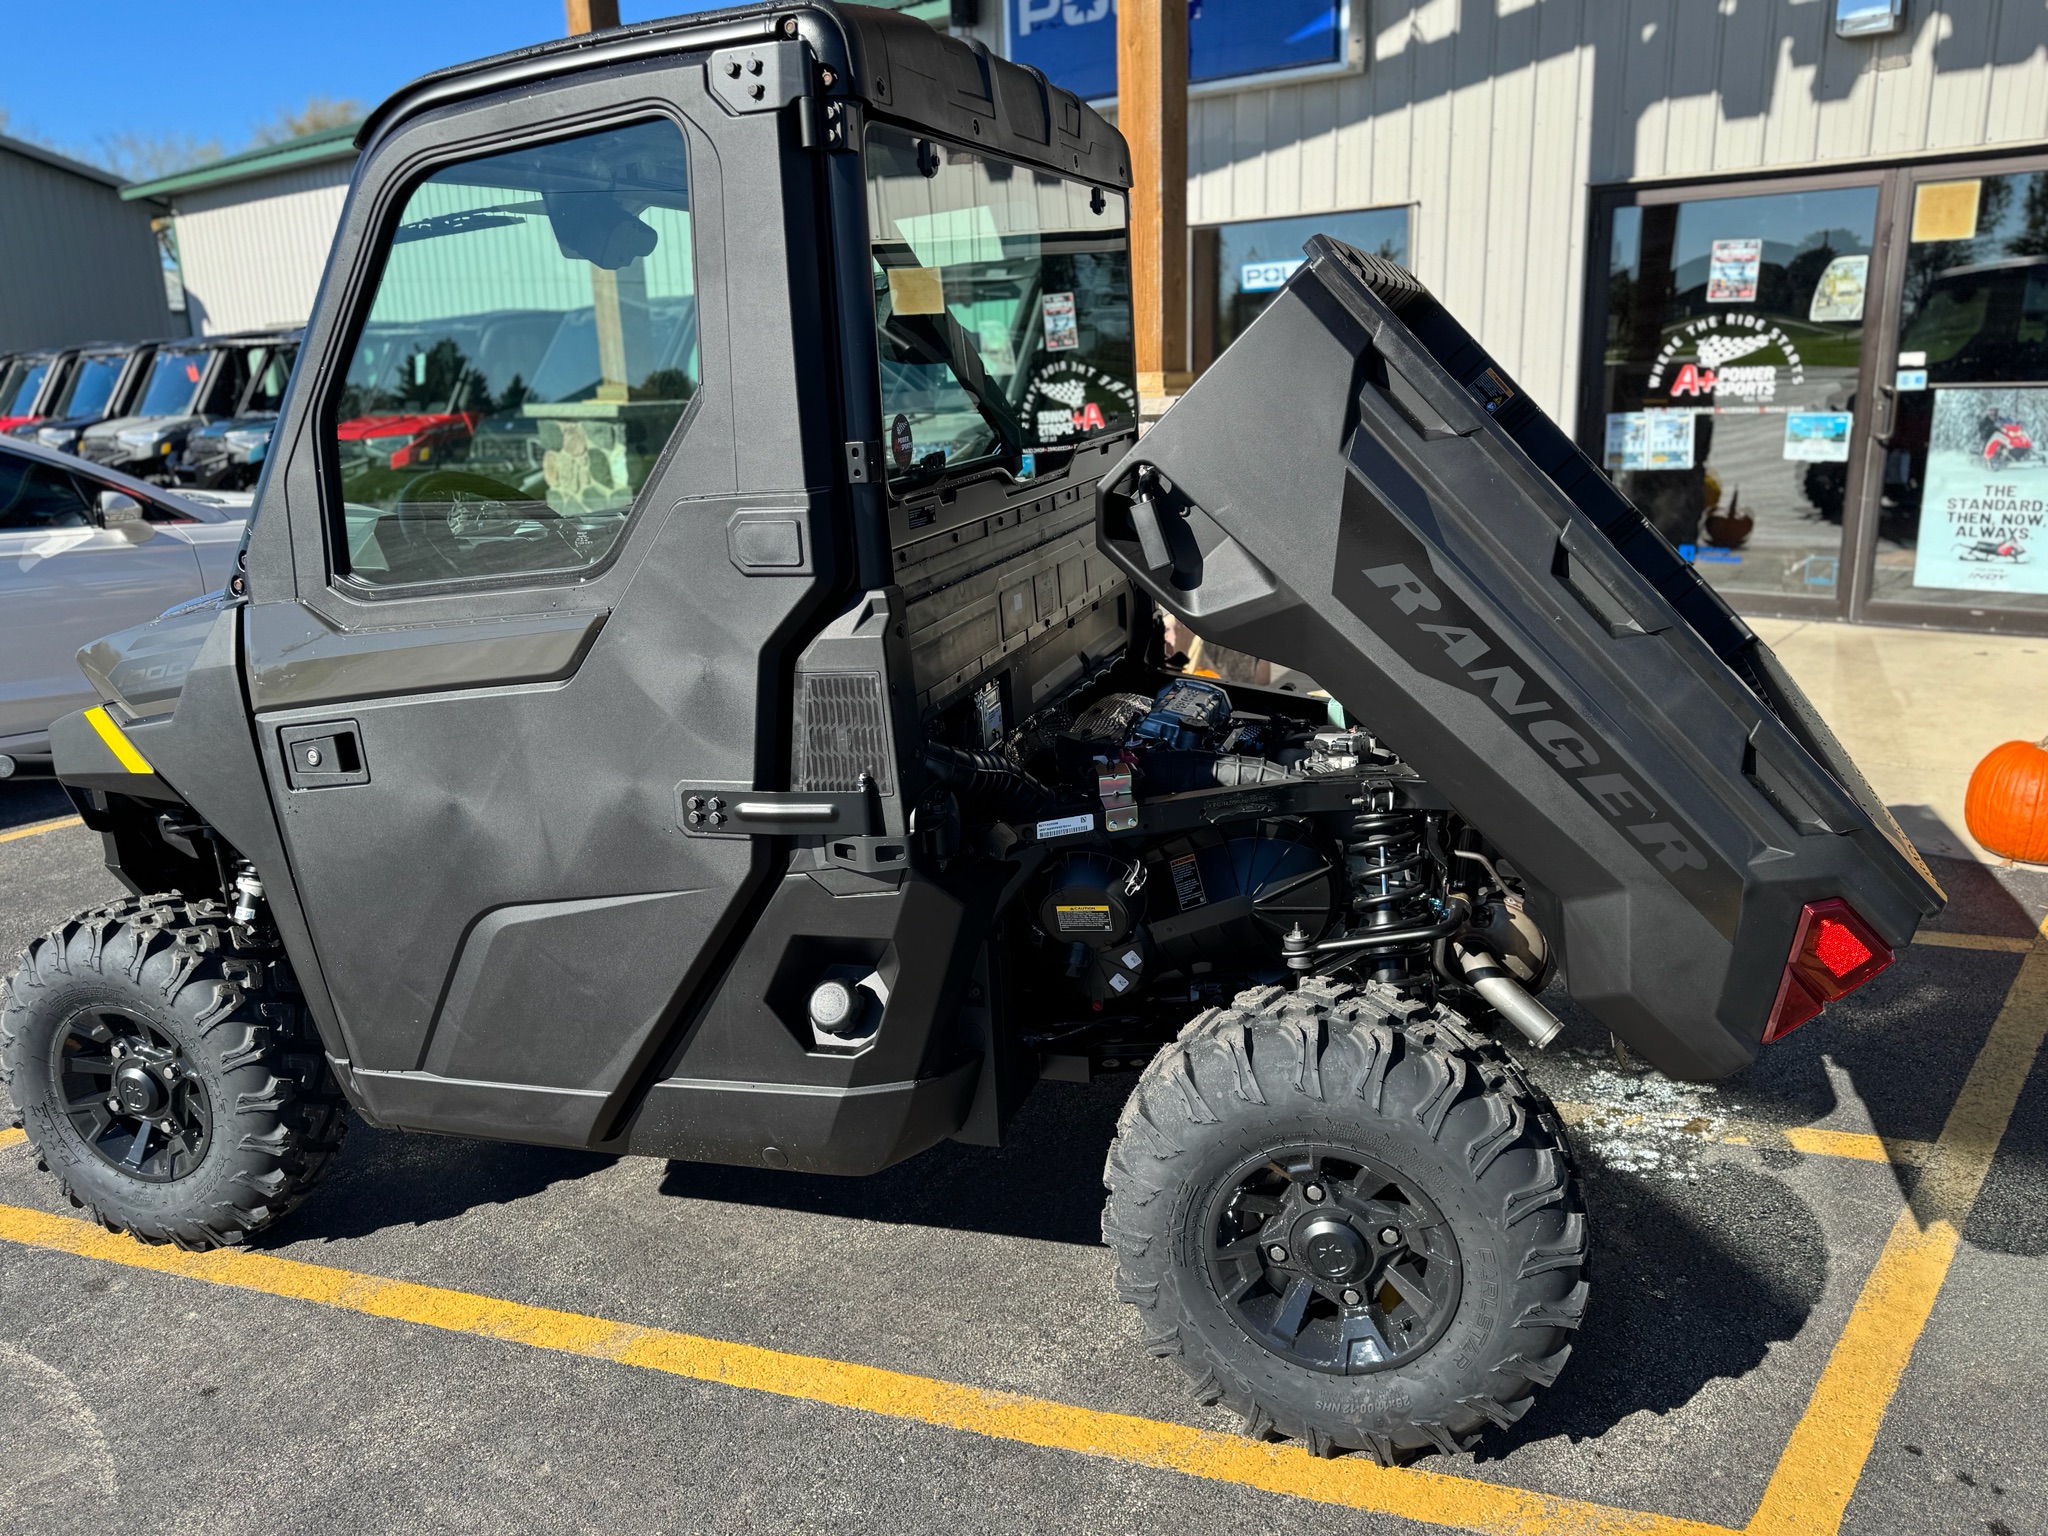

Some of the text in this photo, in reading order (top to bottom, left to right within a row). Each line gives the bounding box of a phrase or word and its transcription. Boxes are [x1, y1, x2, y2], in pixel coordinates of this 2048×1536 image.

[1648, 313, 1804, 388] WHERE THE RIDE STARTS
[1670, 363, 1718, 396] A+
[1714, 381, 1776, 396] SPORTS
[1718, 366, 1776, 381] POWER
[1984, 485, 2018, 498] THE
[1361, 562, 1709, 874] RANGER
[1452, 1247, 1498, 1371] CARLSTAR
